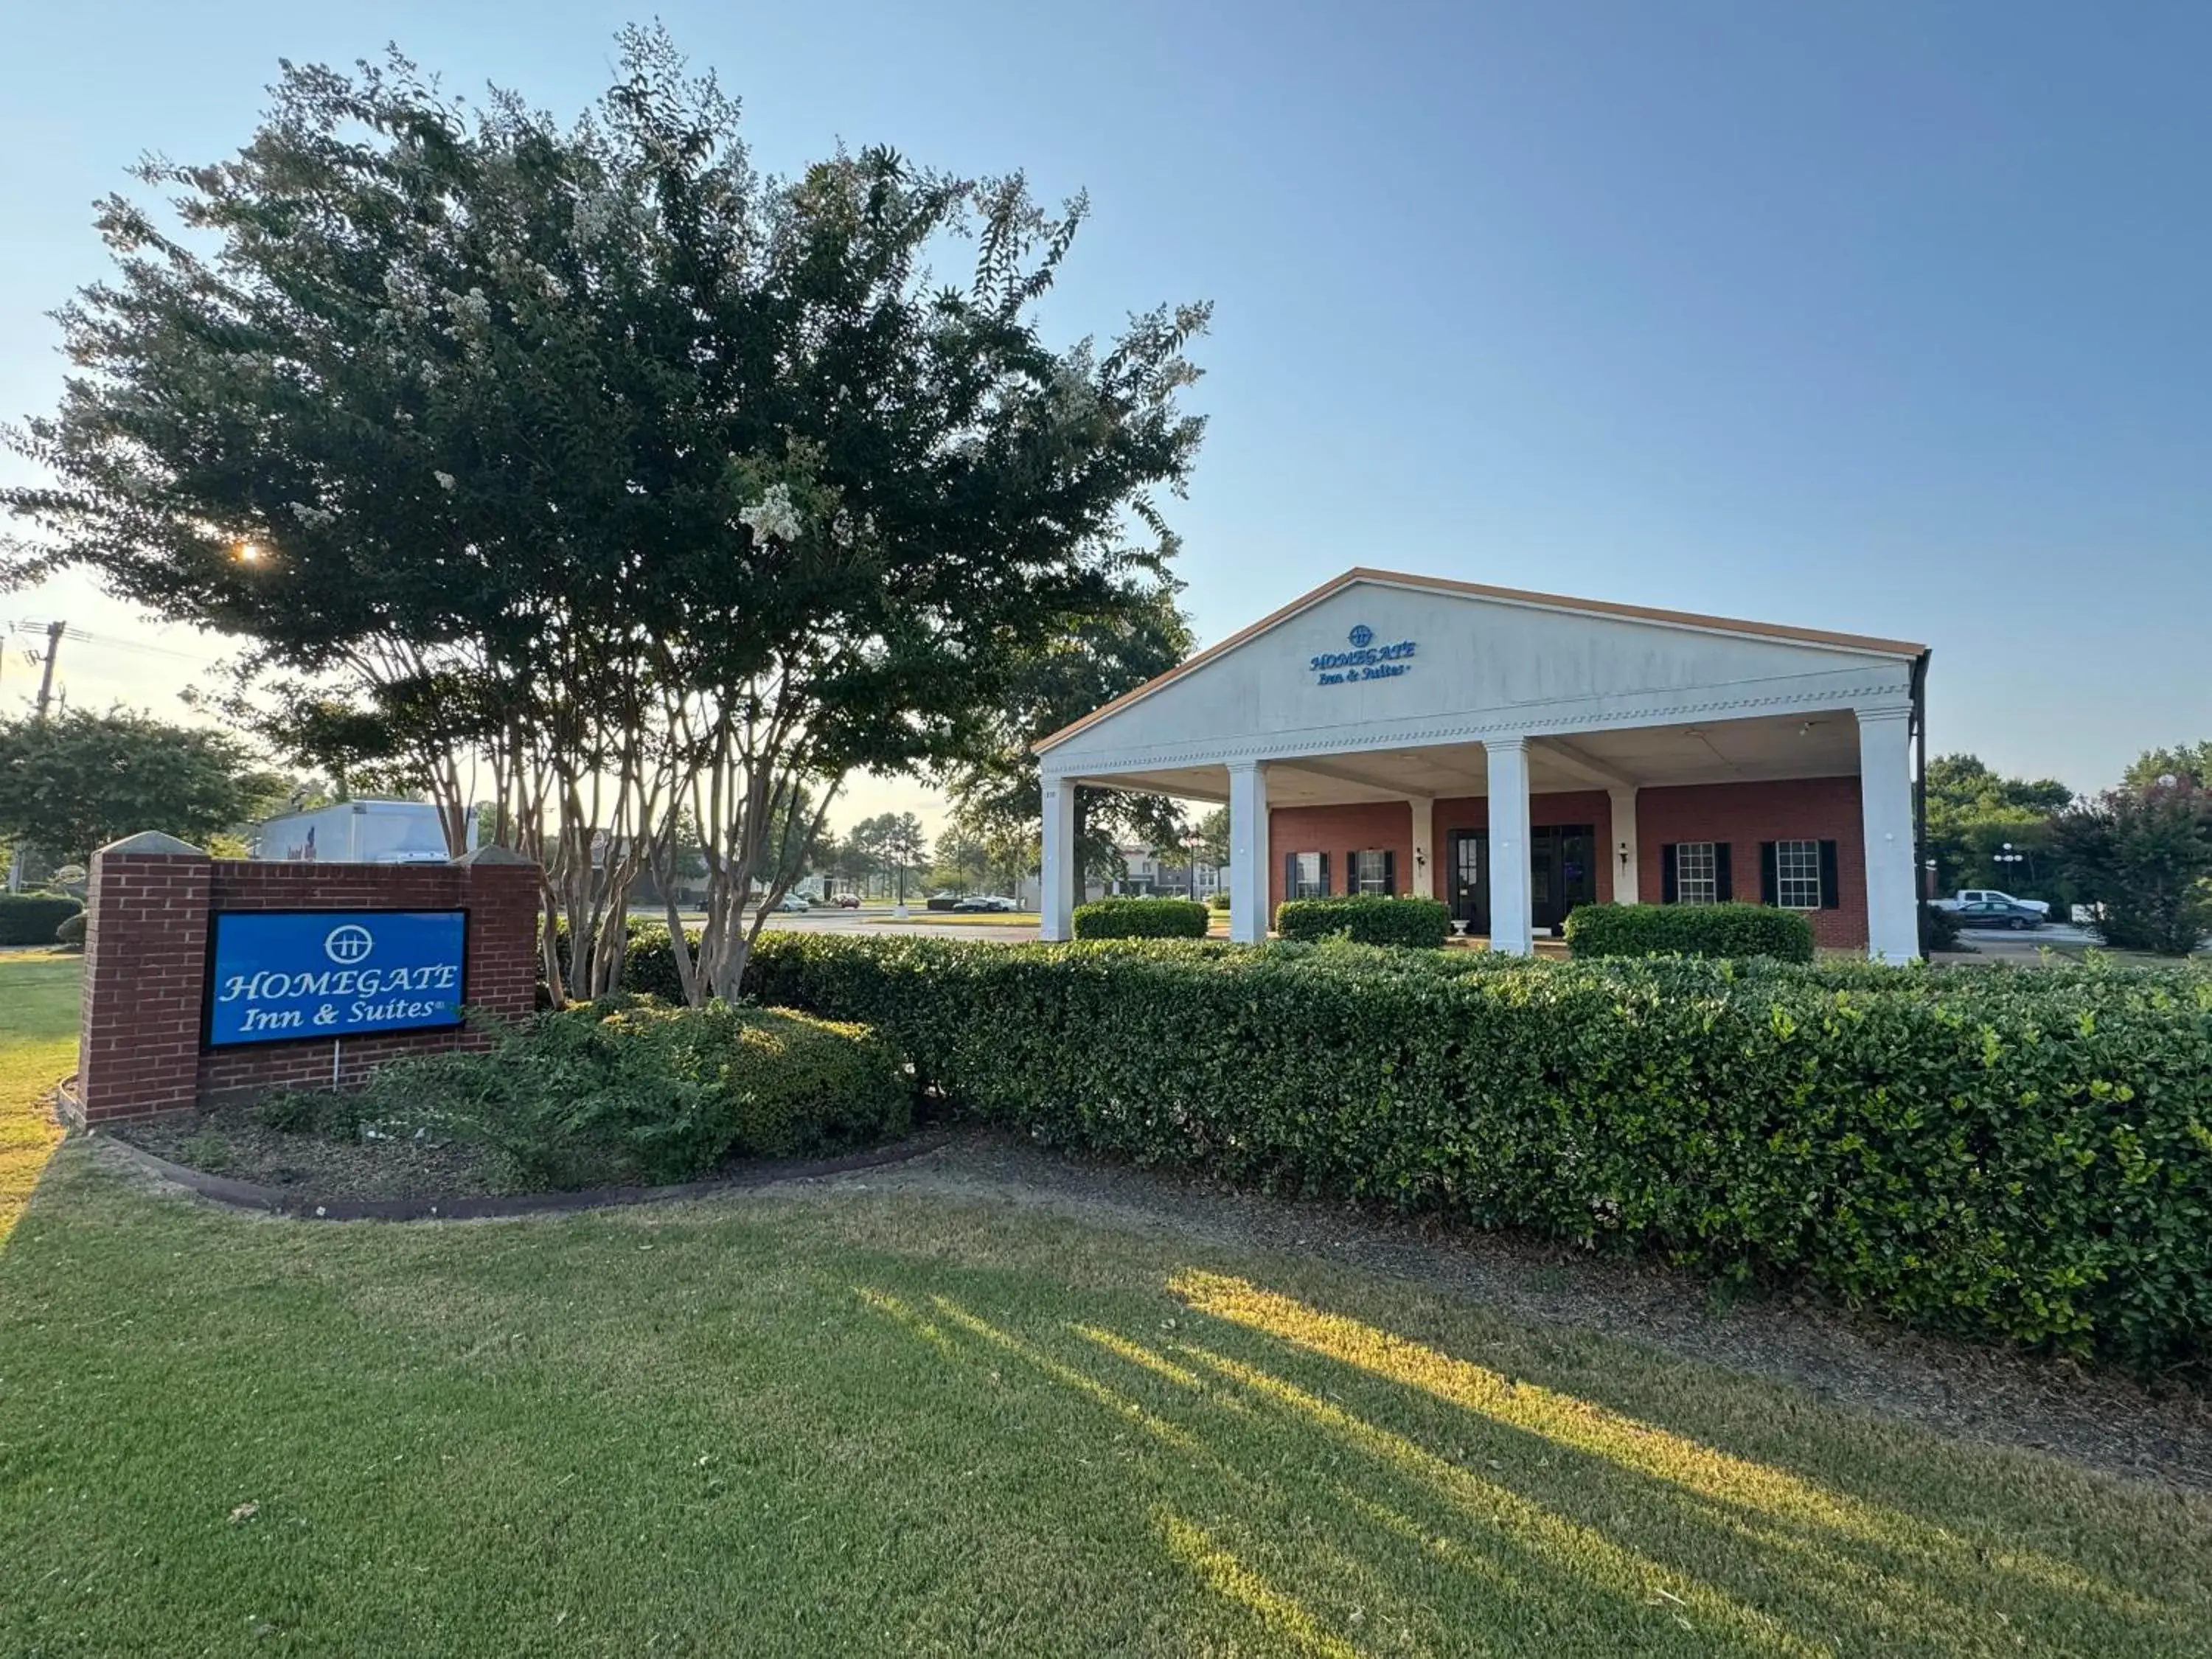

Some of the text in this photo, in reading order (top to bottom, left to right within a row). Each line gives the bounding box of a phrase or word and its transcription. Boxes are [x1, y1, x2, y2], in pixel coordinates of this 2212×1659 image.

[1310, 641, 1416, 671] HOMEGATE
[1317, 664, 1405, 686] Inn & Suites
[218, 963, 459, 1001] HOMEGATE
[238, 998, 434, 1032] Inn & Suites
